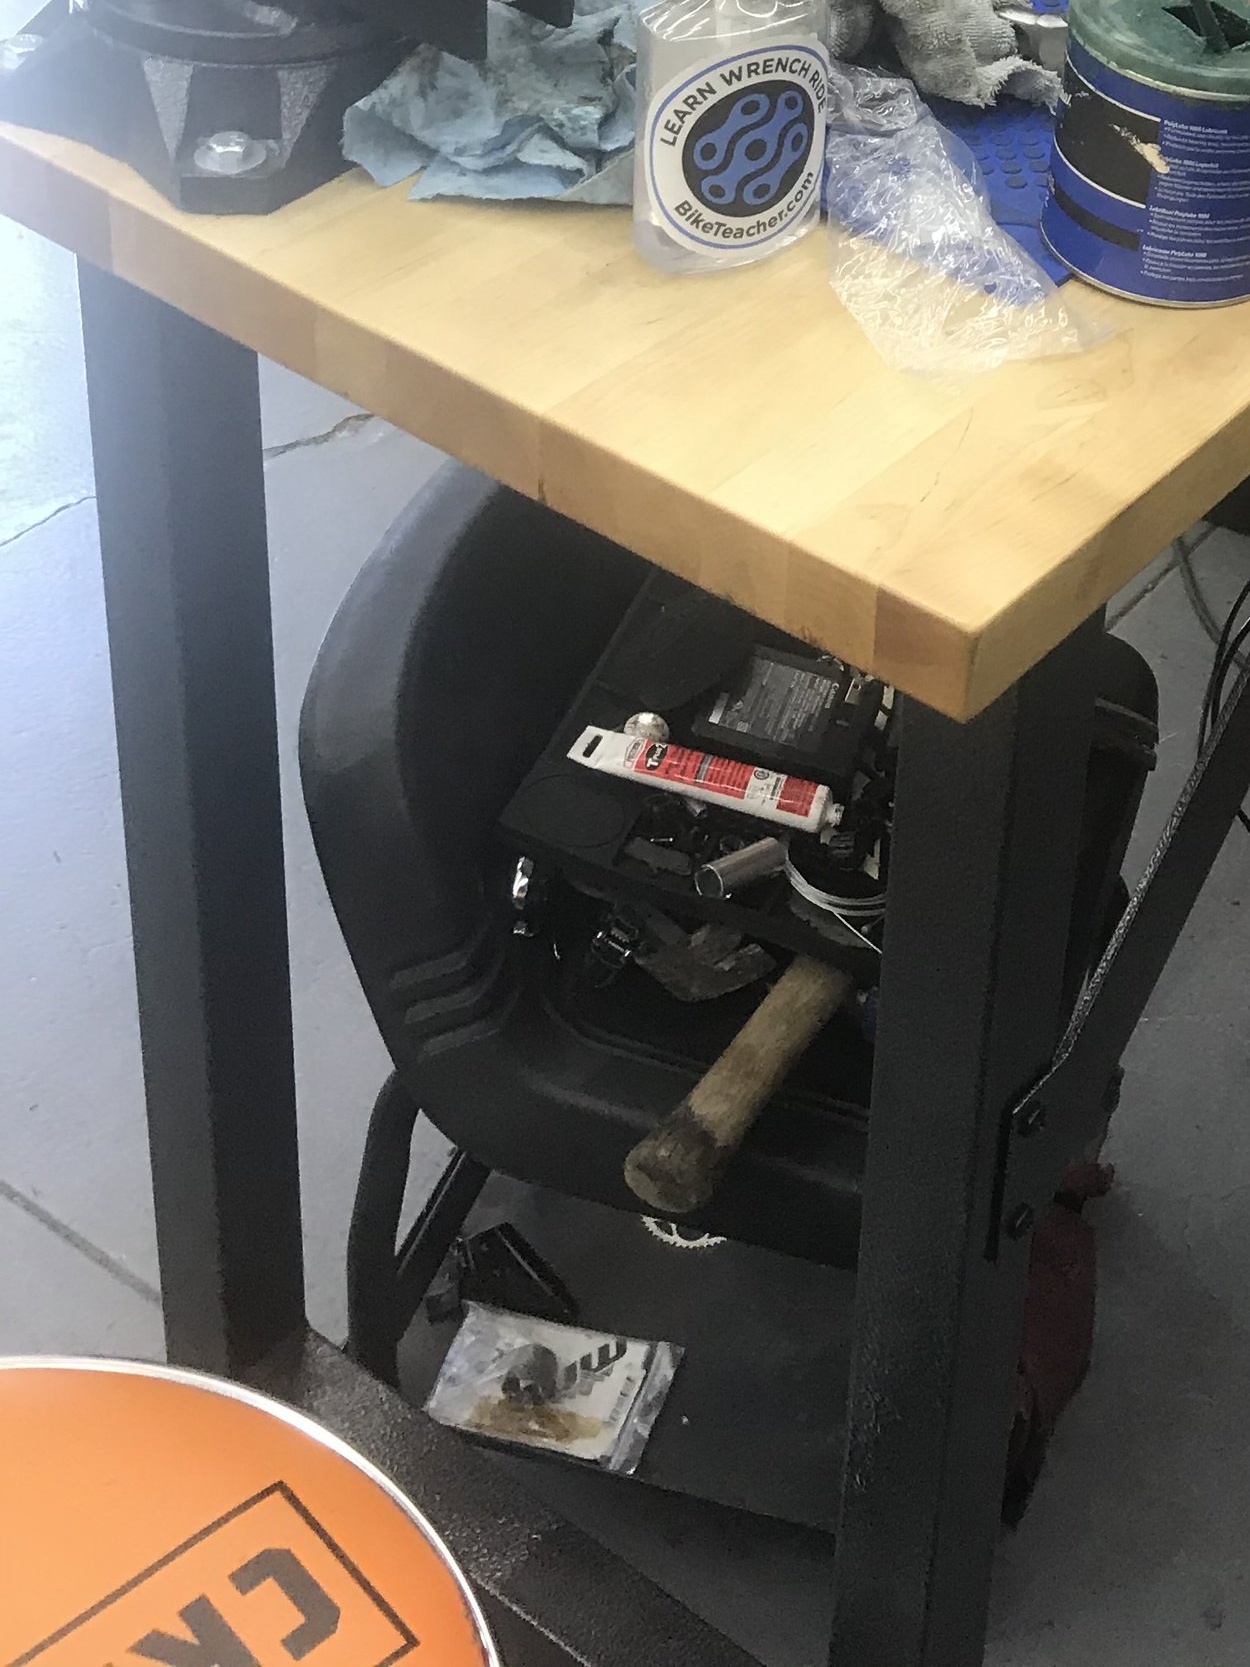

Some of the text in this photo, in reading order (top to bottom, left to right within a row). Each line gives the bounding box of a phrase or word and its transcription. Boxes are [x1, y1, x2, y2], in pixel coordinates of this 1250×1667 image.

[660, 56, 826, 147] LEARN WRENCH RIDE
[674, 171, 814, 239] BikeTeacher.com
